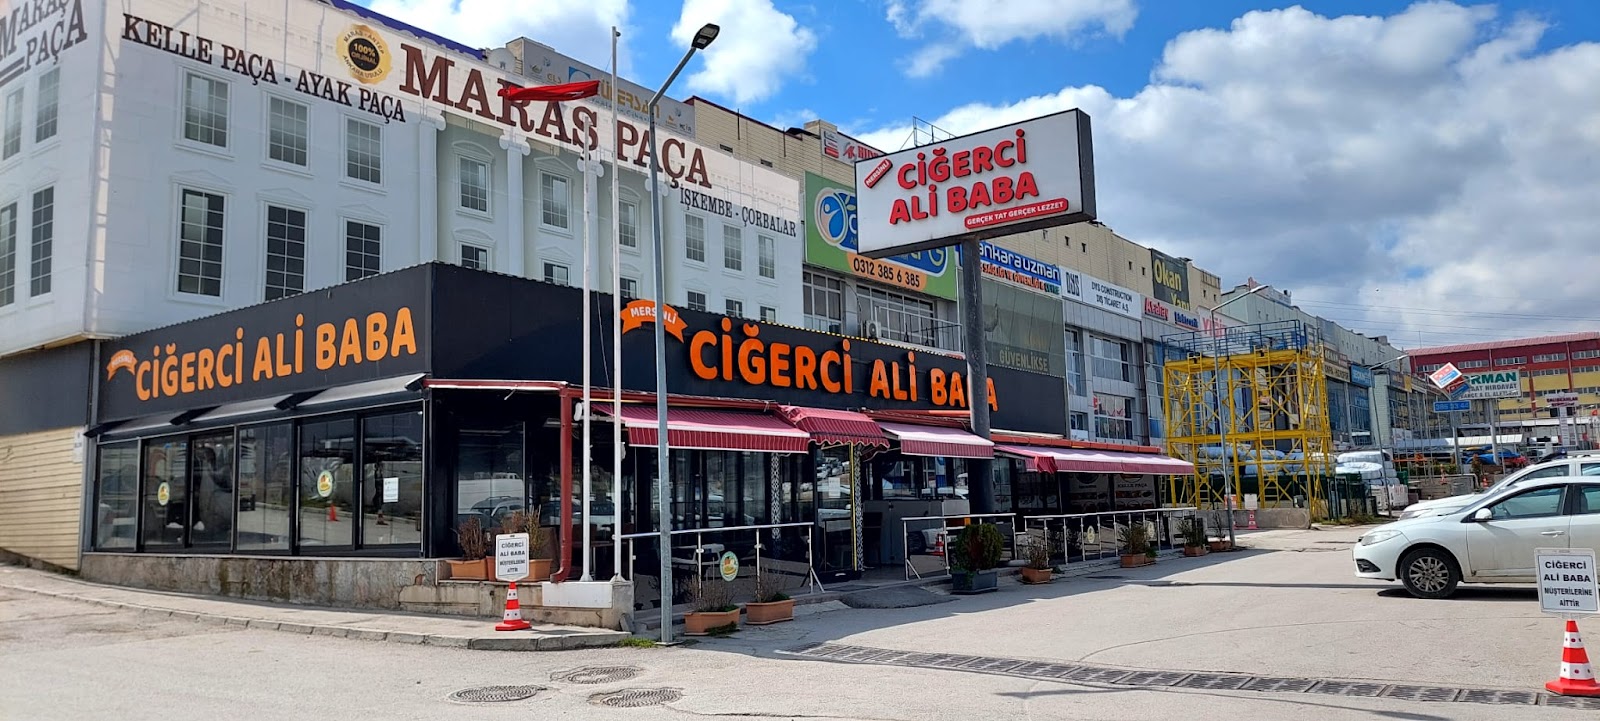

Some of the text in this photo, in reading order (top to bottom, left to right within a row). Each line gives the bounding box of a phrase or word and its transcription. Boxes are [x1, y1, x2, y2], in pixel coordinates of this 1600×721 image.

[24, 0, 88, 72] PAÇA
[353, 43, 377, 58] 100%
[121, 12, 213, 65] KELLE
[221, 44, 278, 86] PAÇA
[295, 69, 353, 107] AYAK
[358, 87, 407, 124] PAÇA
[400, 43, 712, 189] MARAŞ PAÇA
[897, 129, 1027, 190] CİĞERCİ
[864, 160, 890, 187] MERSİNLİ
[889, 184, 938, 225] ALİ
[947, 172, 1040, 213] BABA
[680, 184, 733, 218] İŞKEMBE
[741, 206, 797, 238] ÇORBALAR
[967, 201, 1064, 225] GERÇEK TAT GERÇEK LEZZET
[853, 258, 921, 288] 0312 385 6 385
[1154, 259, 1182, 291] Okan
[1101, 284, 1133, 302] CONSTRUCTION
[1103, 295, 1121, 311] TİCARET
[630, 306, 677, 325] MERSNLİ
[135, 307, 417, 400] CİĞERCİ ALİ BABA
[690, 317, 998, 412] CİĞERCİ ALİ BAA
[1000, 347, 1049, 371] GÜVENLİKSE
[1485, 383, 1517, 391] HIRDAVAT
[501, 541, 524, 549] CİĞERCİ
[1545, 560, 1587, 570] CİĞERCİ
[1543, 573, 1592, 583] ALİ BABA
[1544, 586, 1593, 597] MÜŞTERİLERİNE
[1560, 599, 1580, 607] AİTTİR
